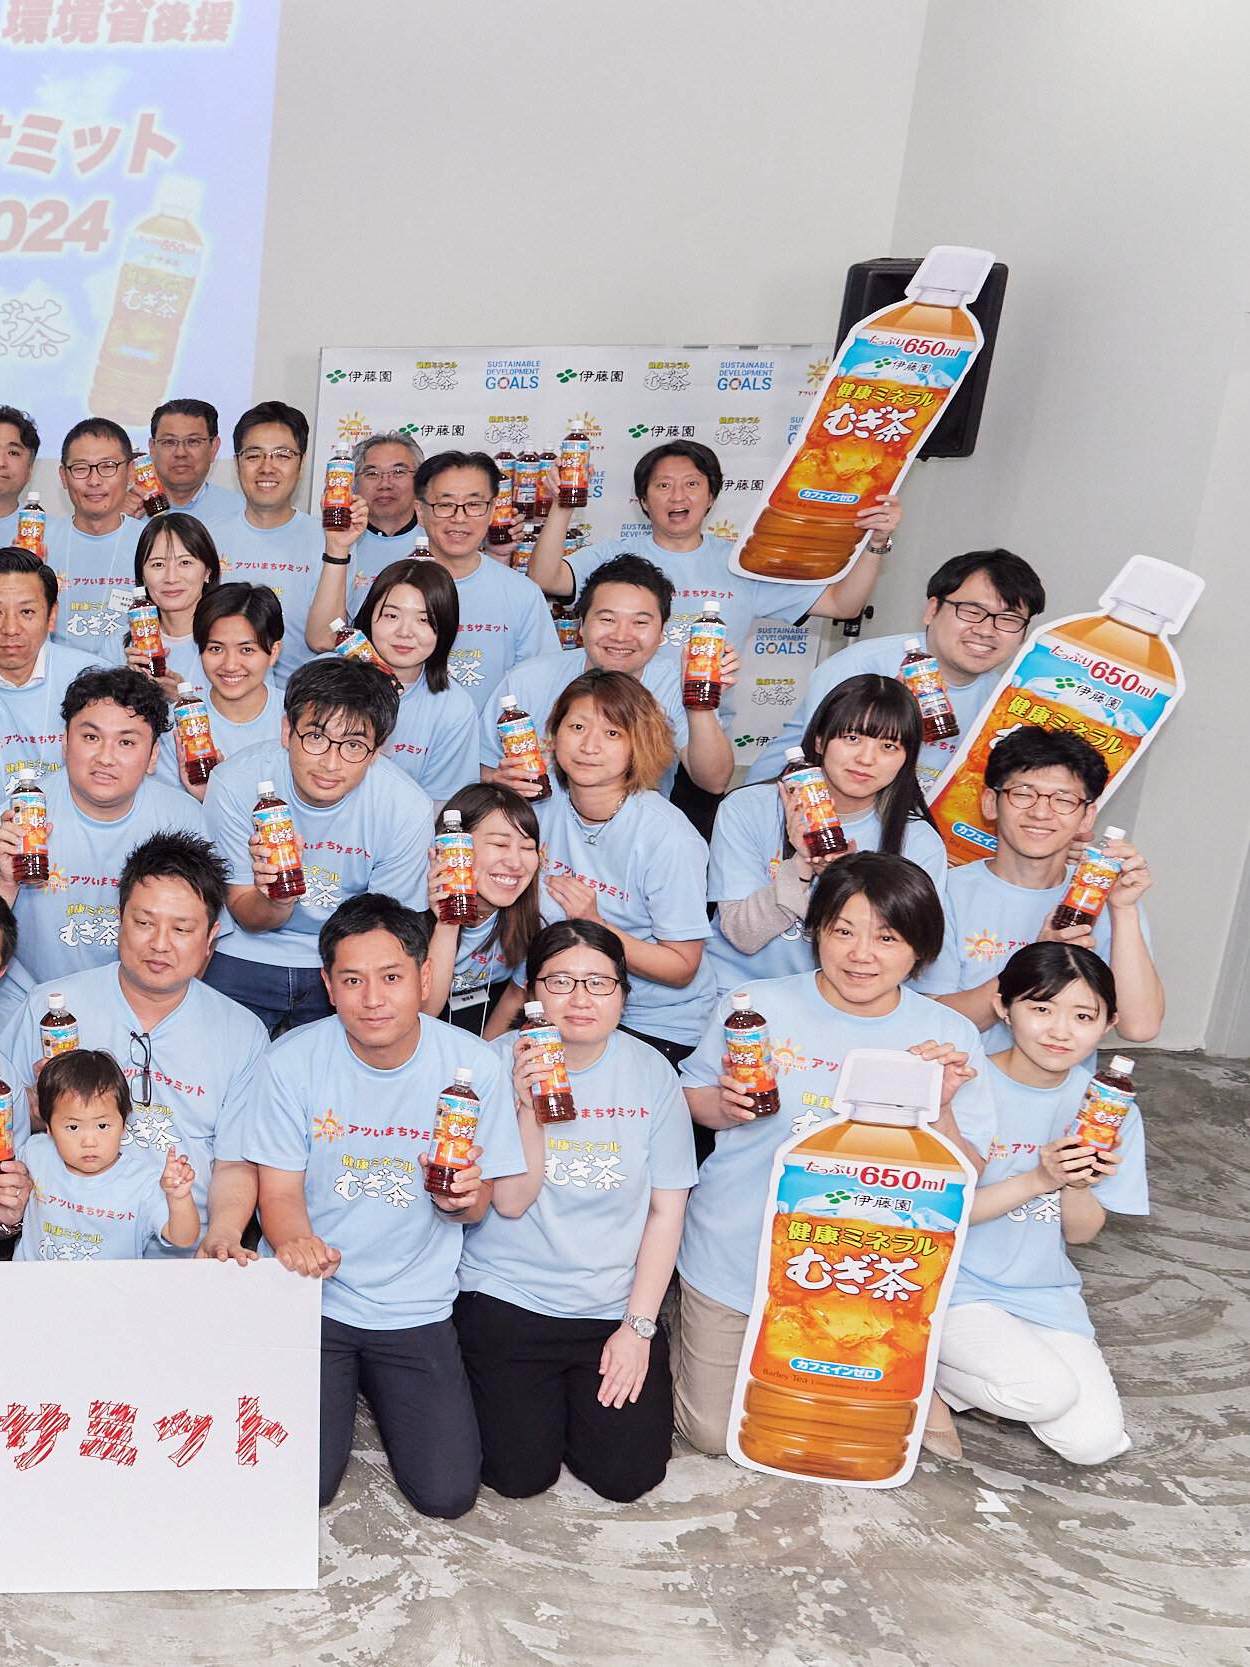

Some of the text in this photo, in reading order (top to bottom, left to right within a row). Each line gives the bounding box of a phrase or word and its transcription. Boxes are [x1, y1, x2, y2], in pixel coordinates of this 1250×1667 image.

[2, 0, 234, 44] 環境省後援
[868, 334, 962, 360] たっぷり650ml
[349, 370, 392, 383] 伊藤園
[579, 370, 624, 382] 伊藤園
[891, 357, 932, 374] 伊藤園
[486, 375, 539, 390] GOALS
[717, 377, 772, 391] GOALS
[836, 381, 936, 408] 健康ミネラル
[420, 424, 465, 436] 伊藤園
[650, 425, 695, 438] 伊藤園
[822, 402, 918, 444] むぎ茶
[722, 479, 764, 492] 伊藤園
[803, 490, 855, 504] カフェインゼロ
[235, 561, 311, 573] アツいまちサミット
[67, 611, 125, 636] むぎ茶
[755, 642, 807, 655] GOALS
[1047, 644, 1158, 700] たっぷり650ml
[1074, 683, 1124, 712] 伊藤園
[1007, 694, 1125, 756] 健康ミネラル
[58, 917, 120, 947] むぎ茶
[341, 1153, 416, 1173] 健康ミネラル
[543, 1152, 628, 1193] むぎ茶
[804, 1158, 947, 1194] たっぷり650ml
[333, 1169, 419, 1209] むぎ茶
[48, 1195, 136, 1221] アツいまちサミット
[852, 1194, 912, 1214] 伊藤園
[786, 1219, 940, 1258] 健康ミネラル
[784, 1247, 923, 1303] むぎ茶
[796, 1359, 876, 1379] カフェインゼロ
